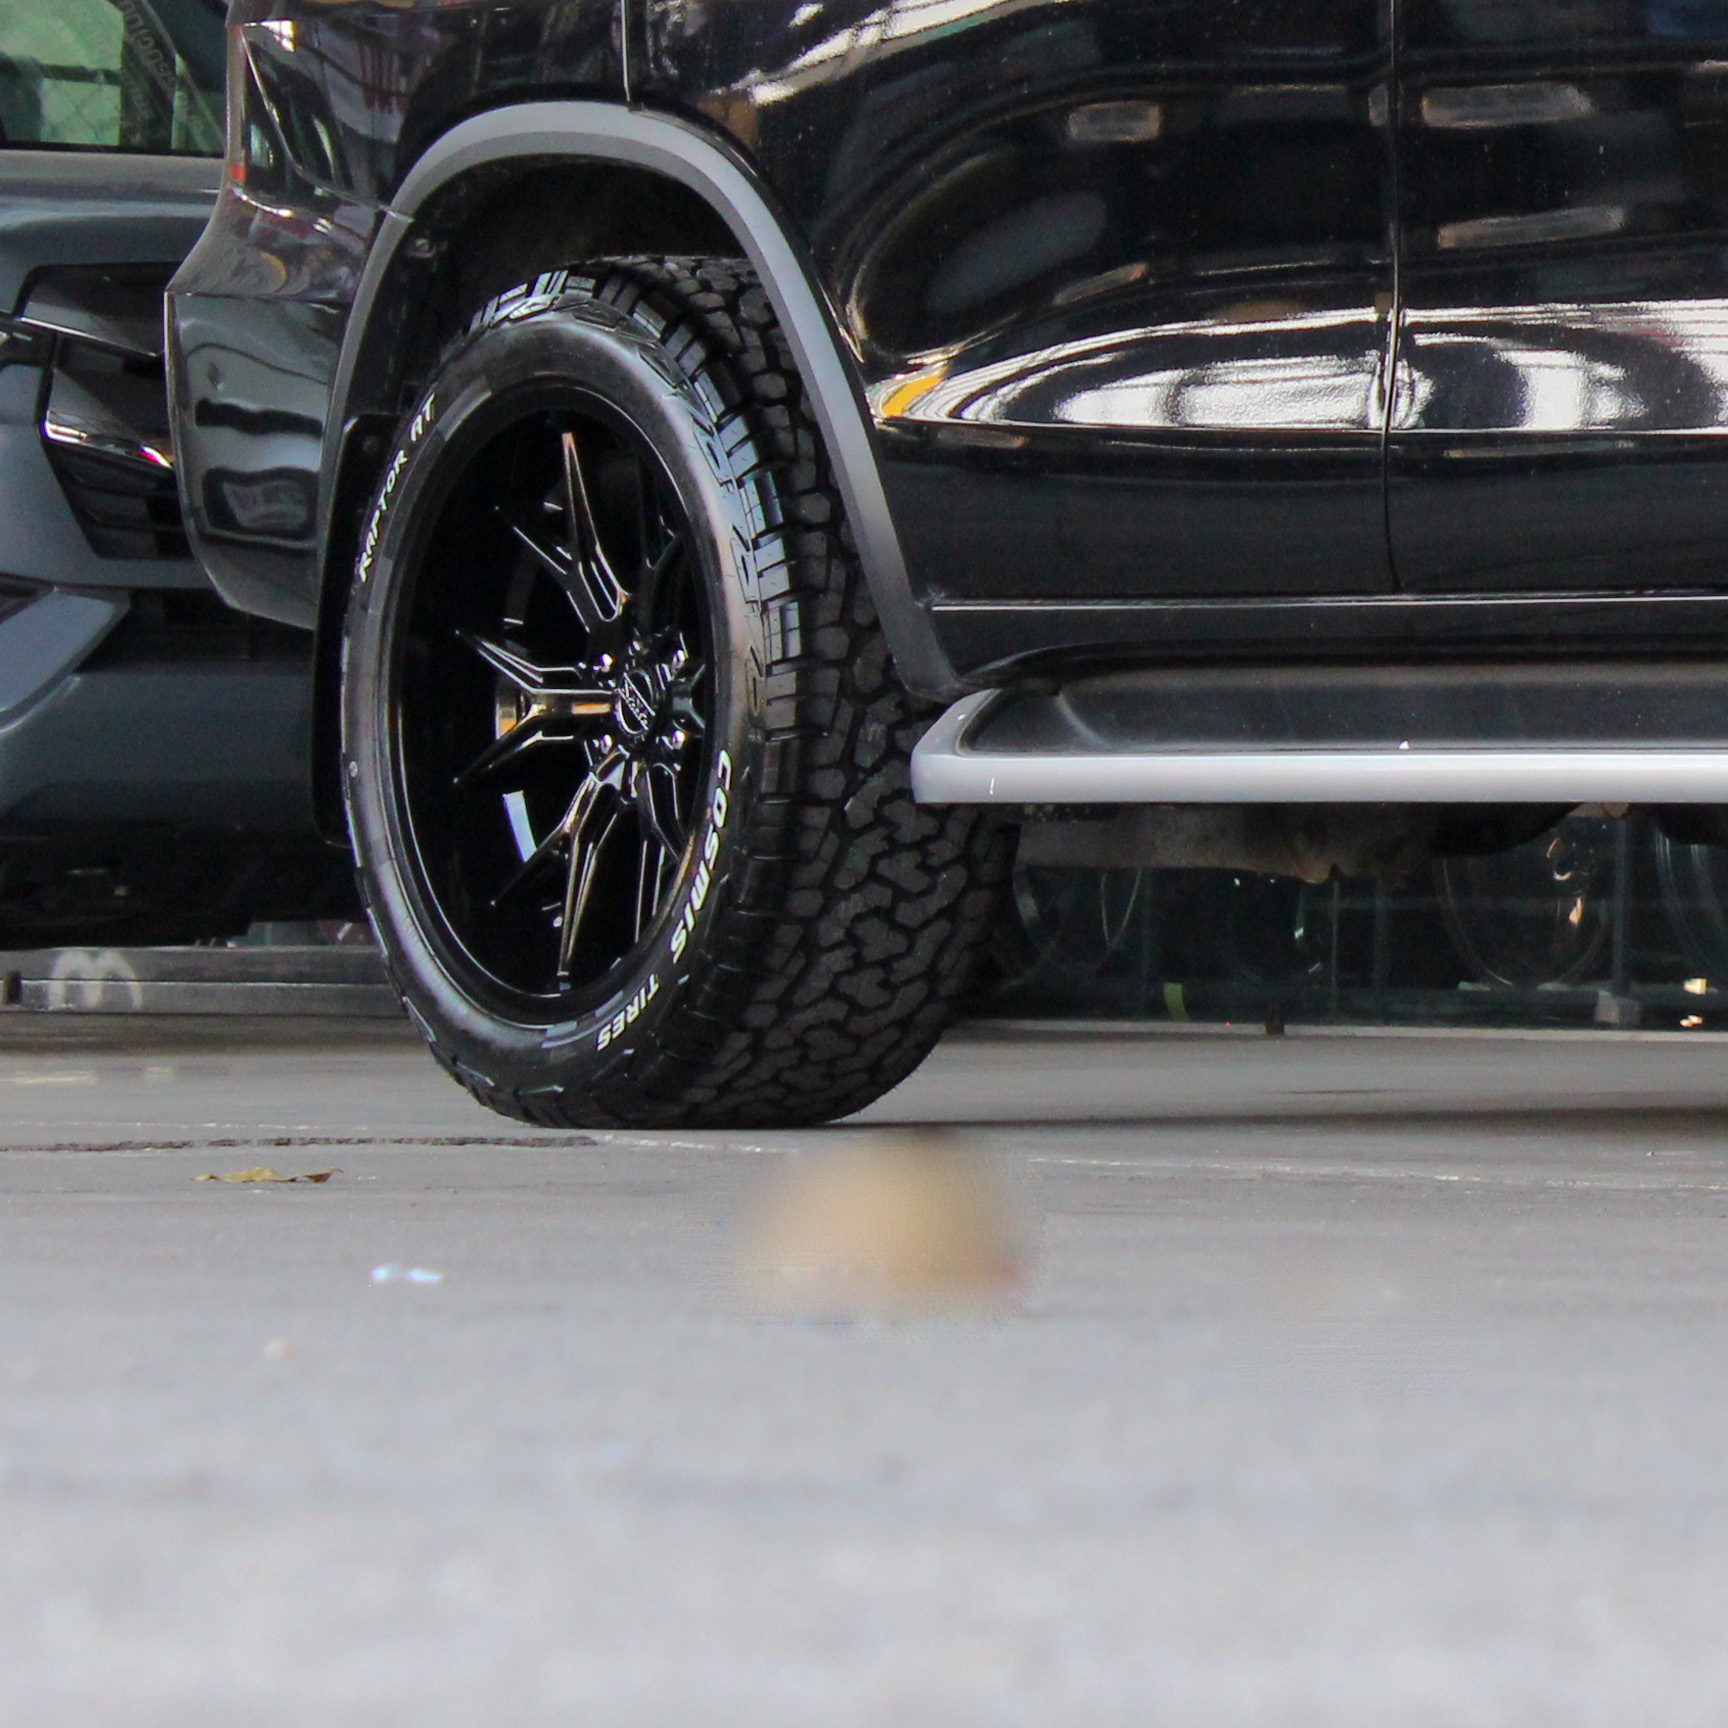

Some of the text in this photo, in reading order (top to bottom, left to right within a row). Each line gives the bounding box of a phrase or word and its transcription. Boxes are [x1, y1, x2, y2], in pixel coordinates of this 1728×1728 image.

[358, 392, 436, 583] RAPTOR AT
[596, 749, 732, 1052] COSMIS TIRES
